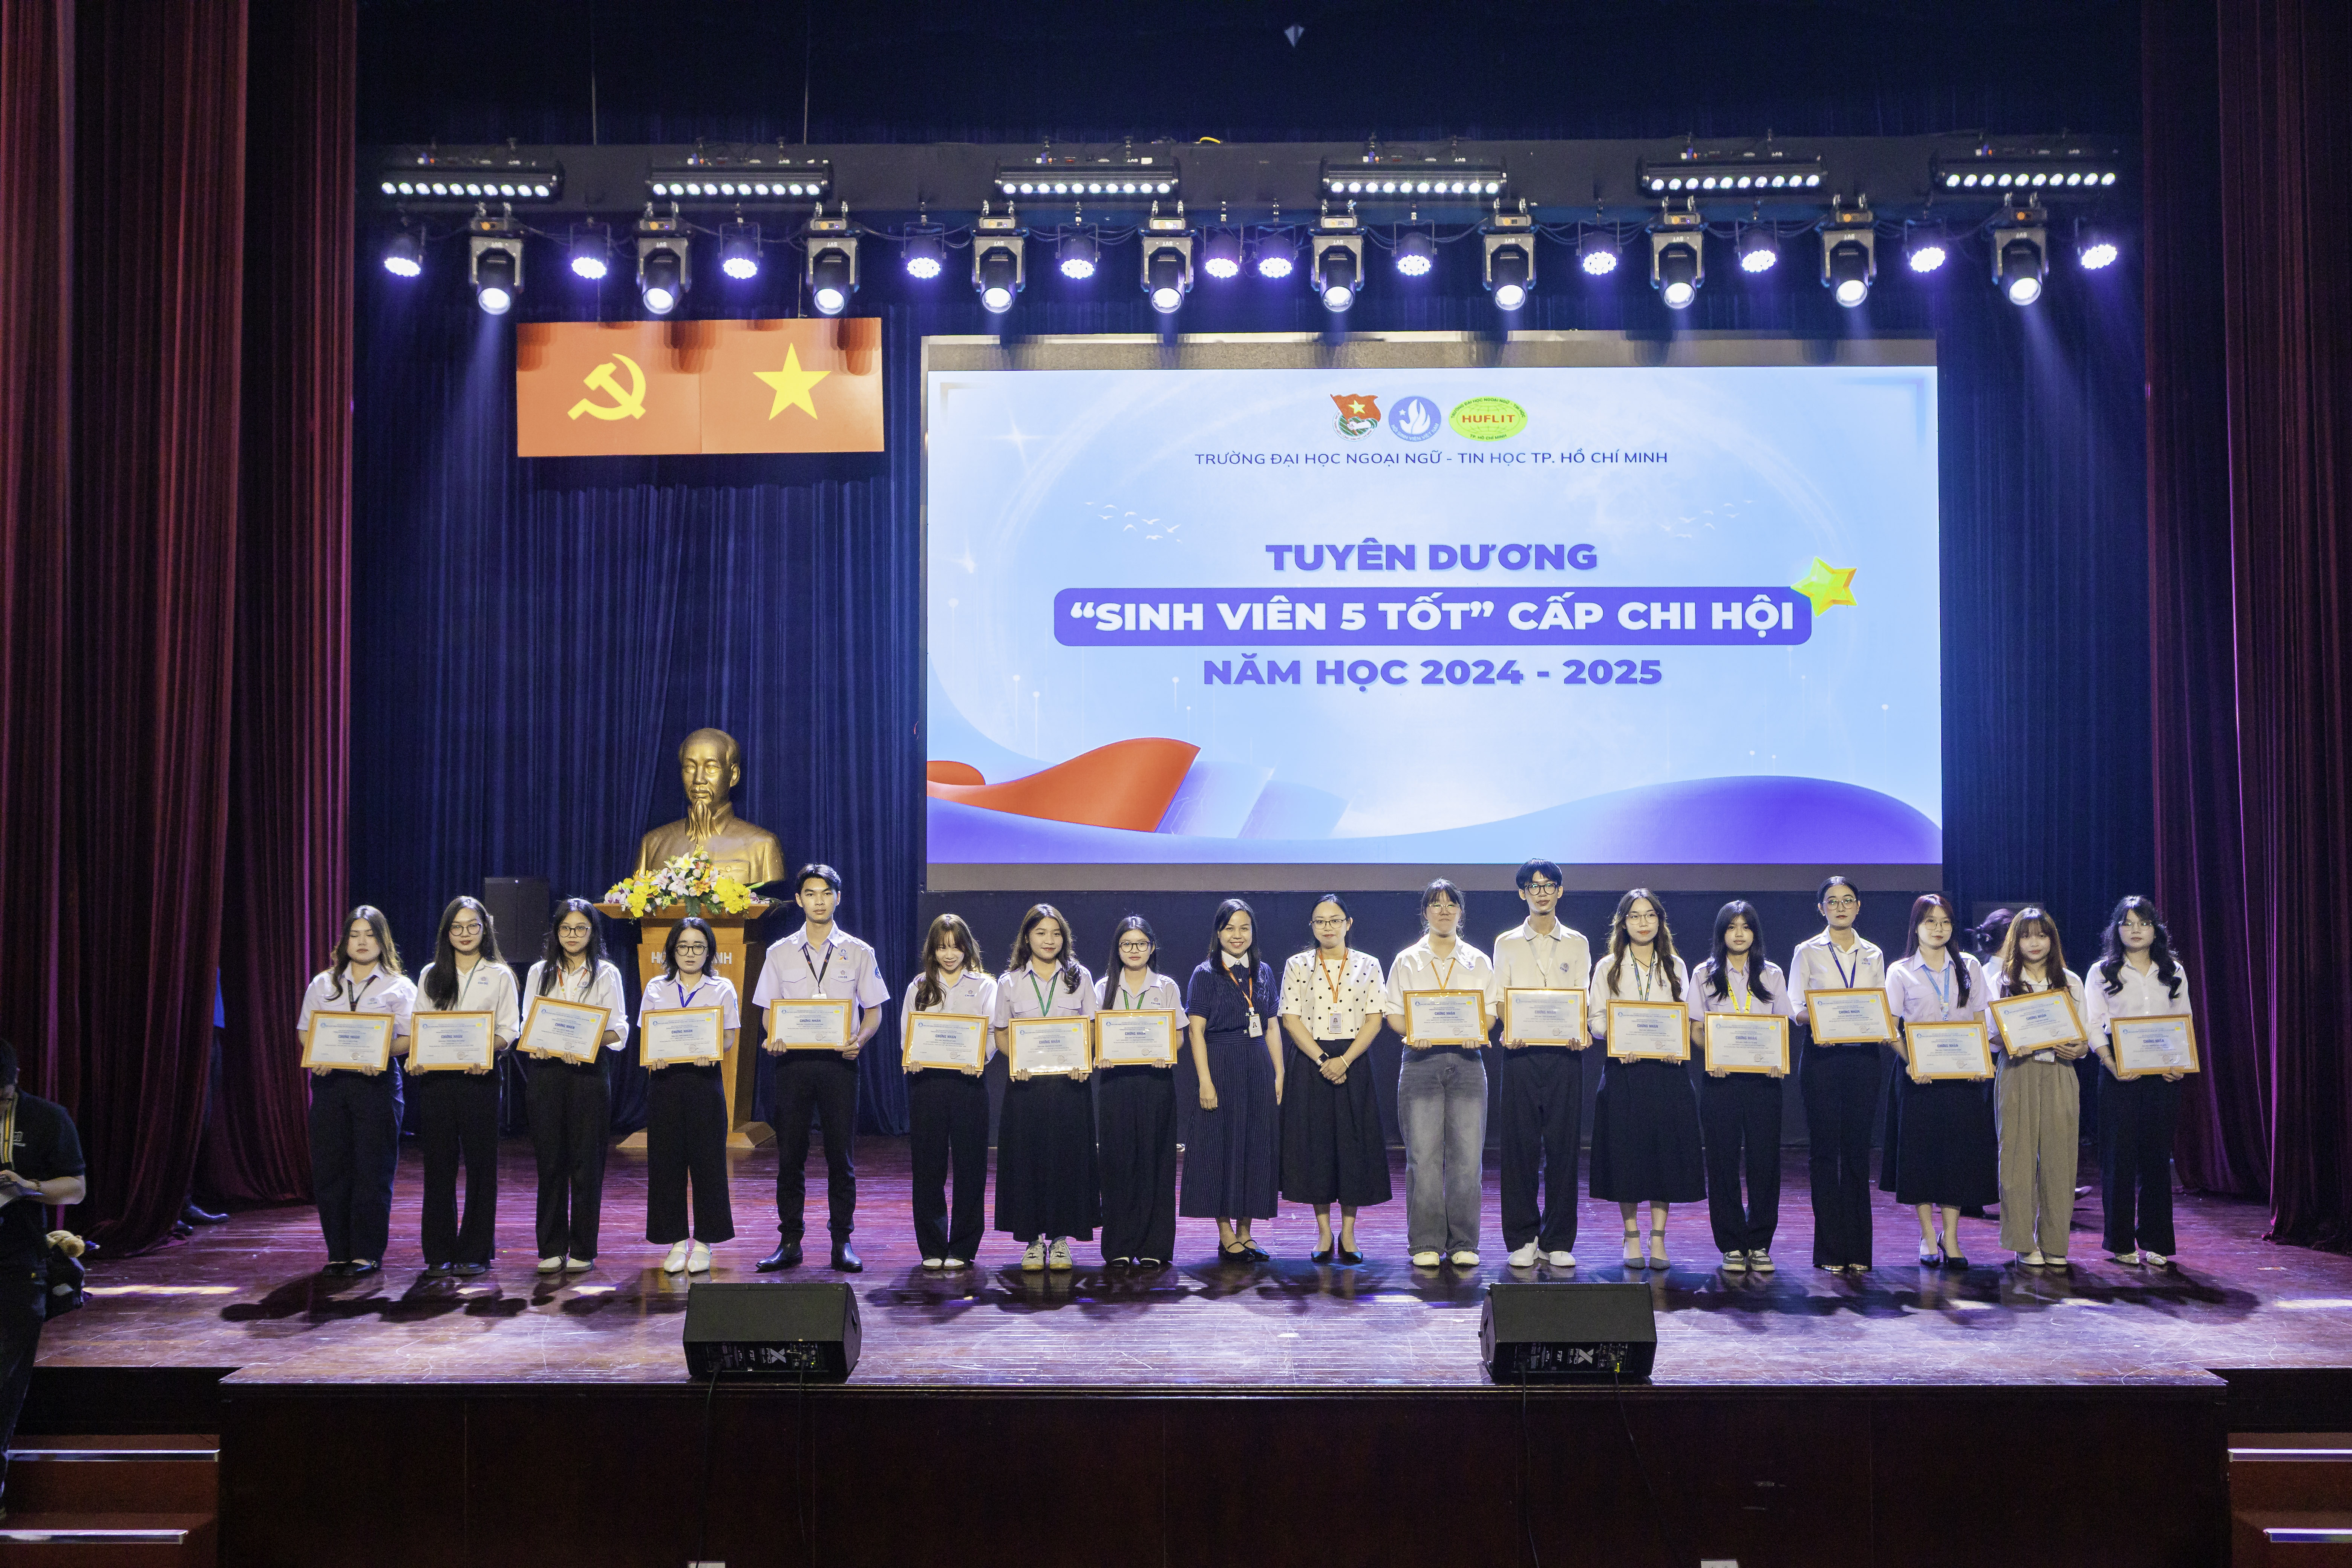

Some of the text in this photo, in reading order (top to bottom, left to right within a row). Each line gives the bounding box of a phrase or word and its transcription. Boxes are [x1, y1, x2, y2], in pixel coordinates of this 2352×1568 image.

[1462, 415, 1515, 423] HUFLIT
[1195, 451, 1265, 465] TRƯỜNG
[1270, 454, 1299, 467] ĐẠI
[1306, 454, 1341, 467] HỌC
[1347, 453, 1399, 467] NGOẠI
[1406, 450, 1442, 464] NGỮ
[1458, 453, 1484, 464] TIN
[1491, 453, 1526, 467] HỌC
[1531, 453, 1555, 464] TP.
[1561, 448, 1585, 464] HỒ
[1591, 449, 1620, 463] CHÍ
[1625, 452, 1668, 463] MINH
[1266, 538, 1597, 571] TUYÊN DƯƠNG
[1071, 593, 1793, 637] “SINH VIÊN 5 TỐT” CẤP CHI HỘI
[1204, 653, 1301, 685] NĂM
[1317, 660, 1408, 692] HỌC
[1421, 660, 1524, 685] 2024
[1563, 660, 1662, 685] 2025
